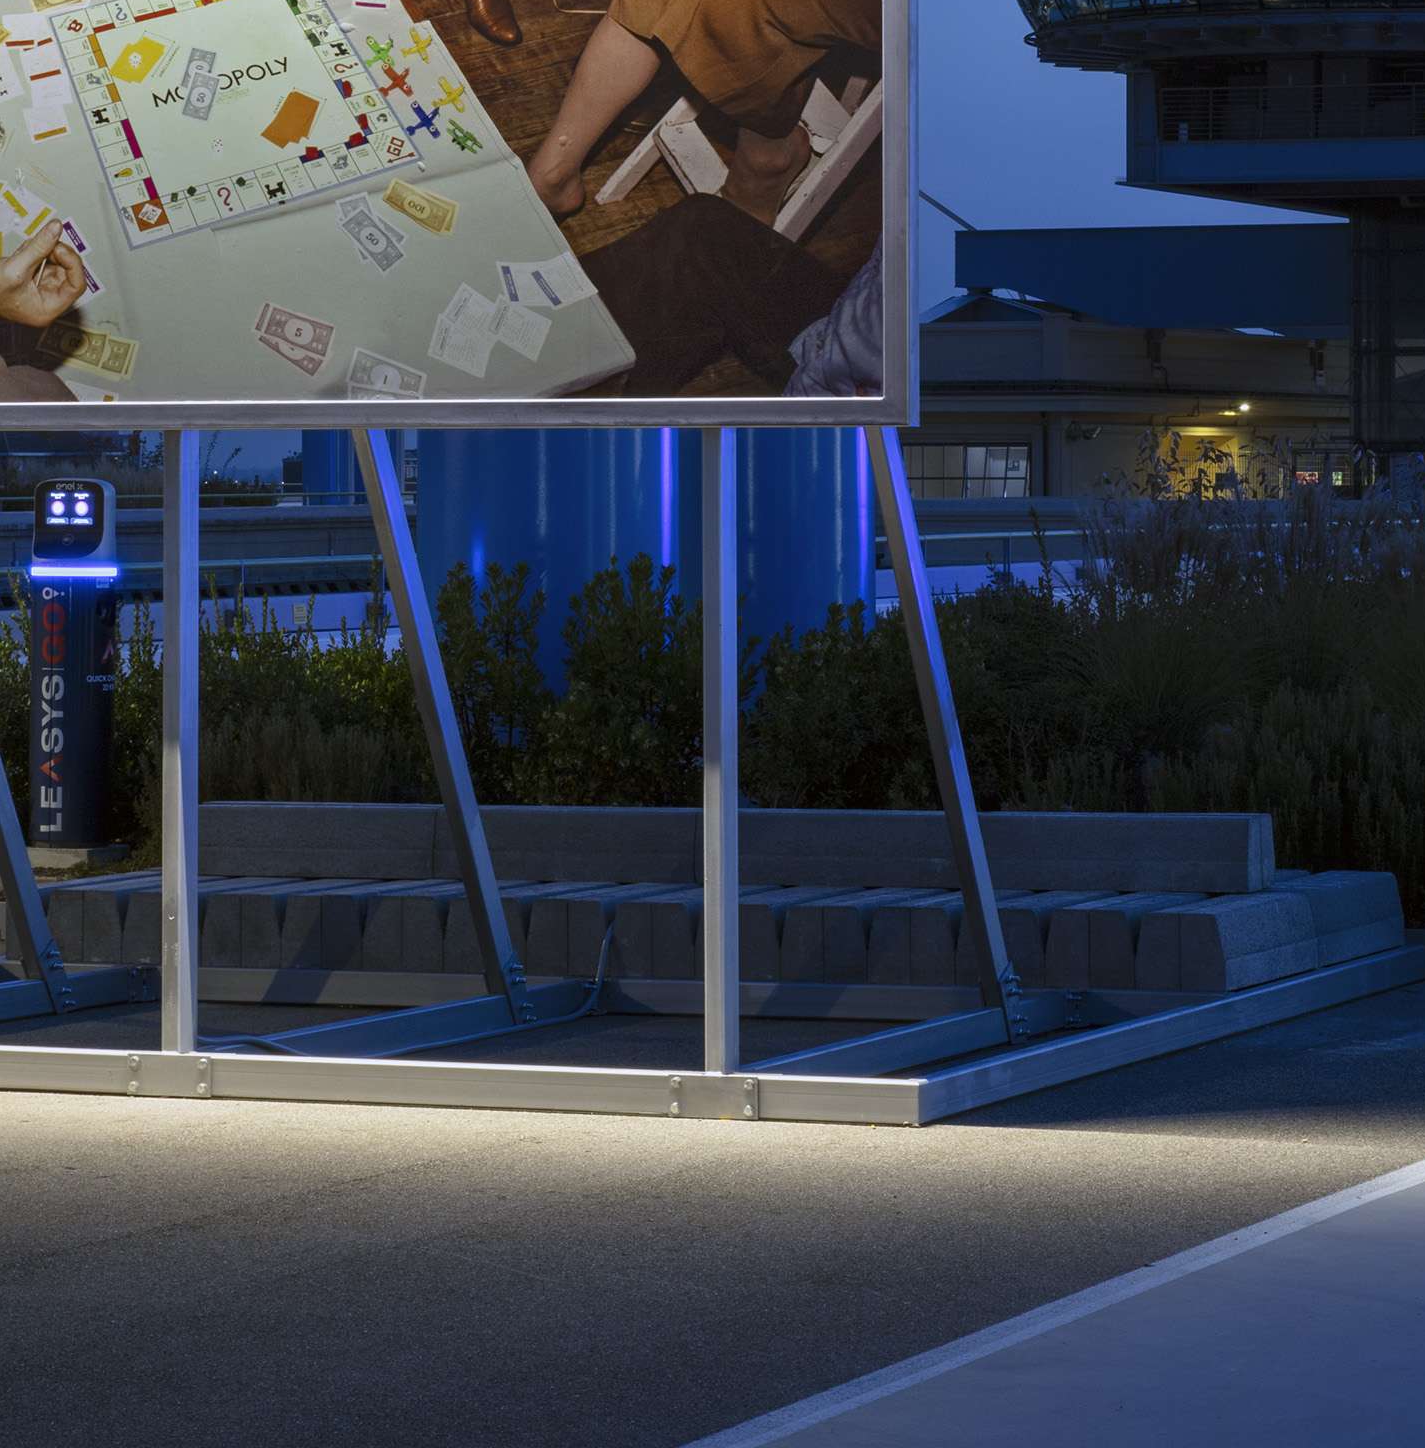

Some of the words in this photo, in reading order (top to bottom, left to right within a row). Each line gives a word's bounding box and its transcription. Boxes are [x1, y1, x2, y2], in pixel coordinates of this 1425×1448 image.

[386, 136, 405, 156] GO
[407, 200, 426, 215] 100
[365, 232, 380, 246] 50
[294, 327, 303, 338] 5
